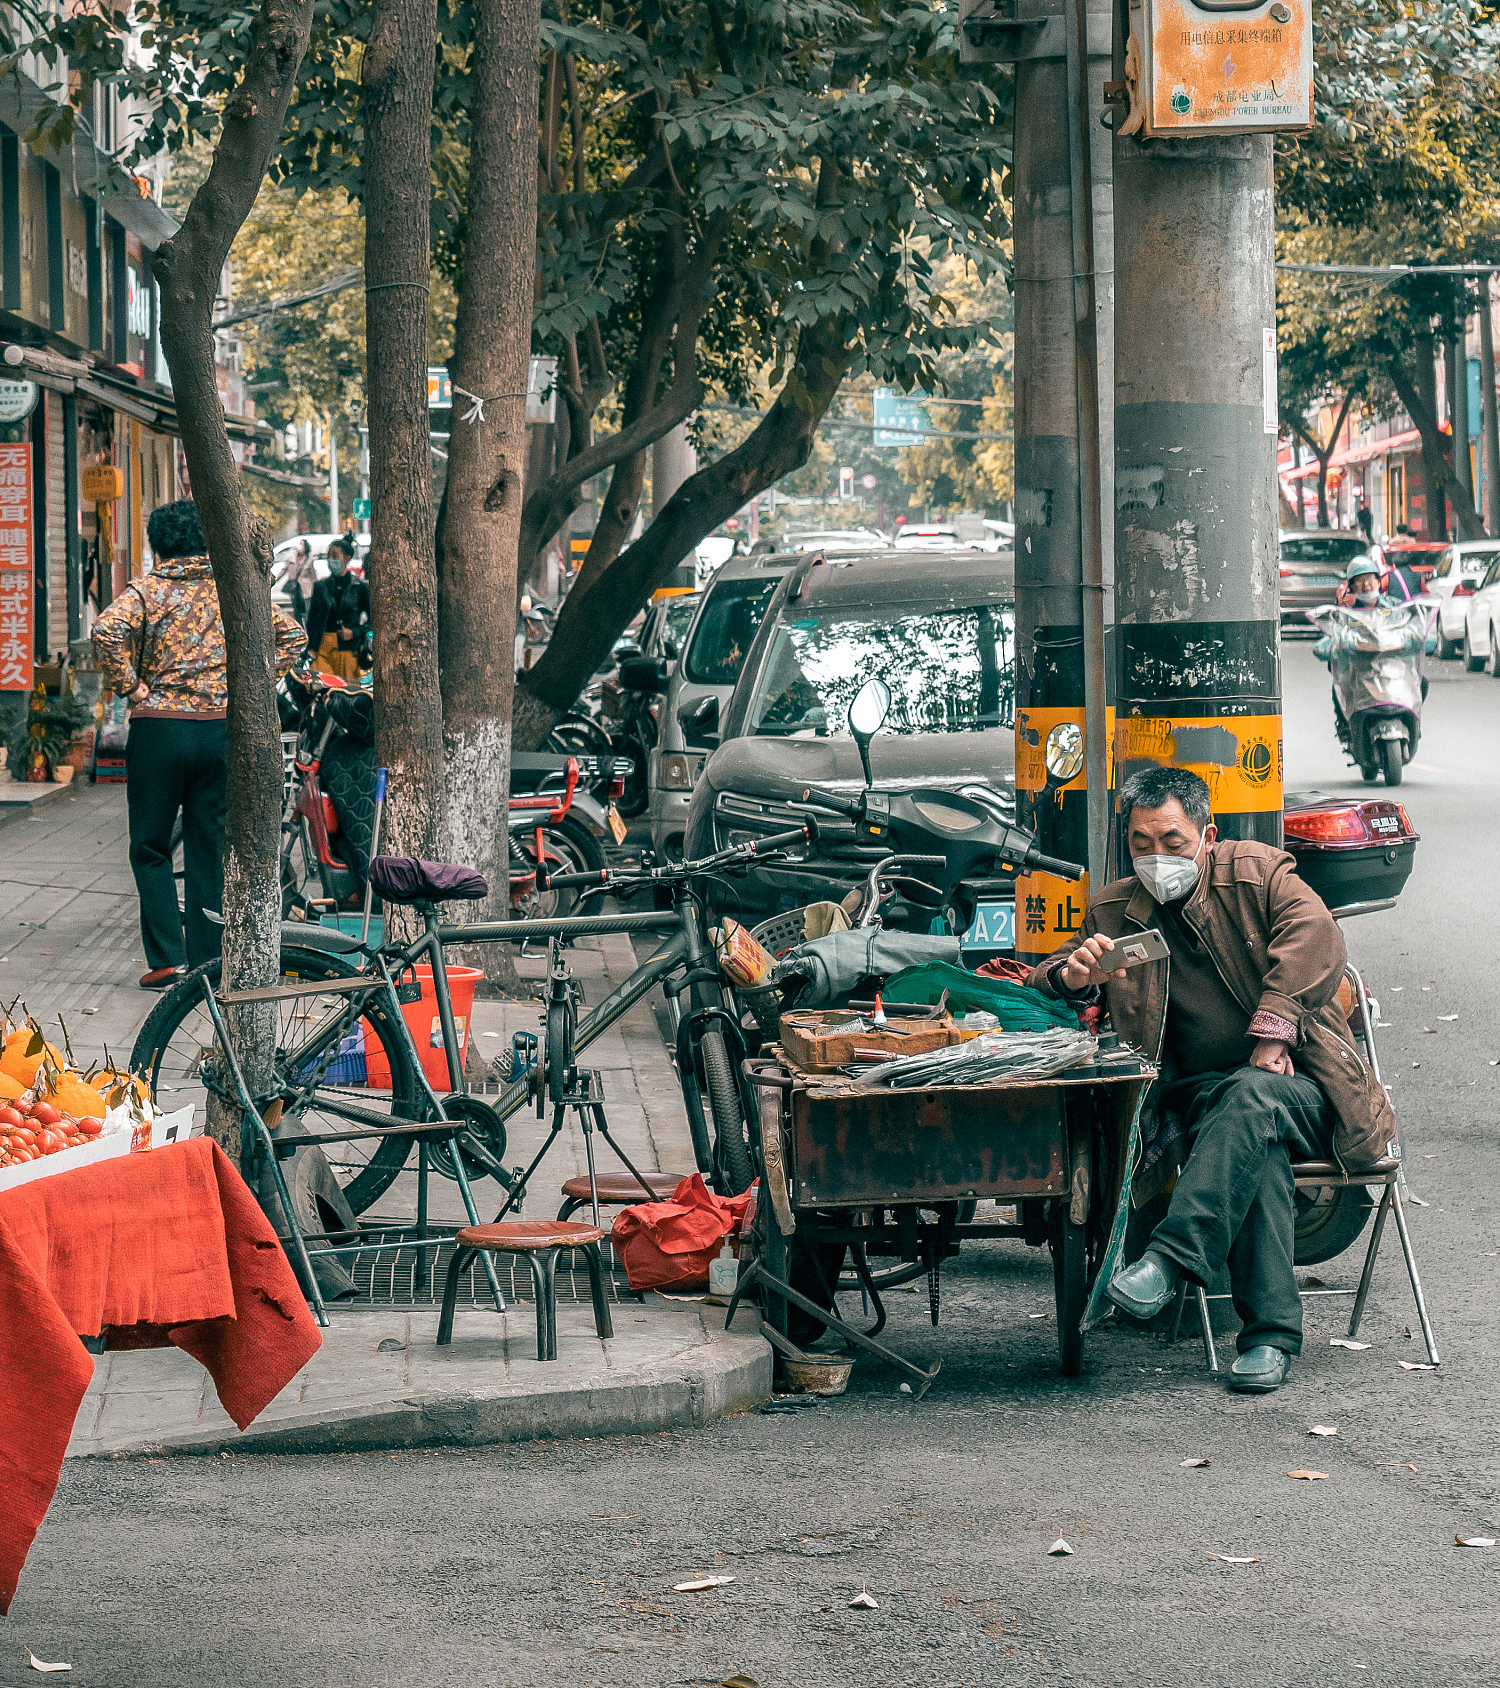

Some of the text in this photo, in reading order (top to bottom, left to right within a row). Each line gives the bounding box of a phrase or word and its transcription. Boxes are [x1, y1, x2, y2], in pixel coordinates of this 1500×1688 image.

[1180, 29, 1283, 46] 用电信息采集终端箱
[1213, 90, 1275, 103] 成都电业局
[1233, 107, 1259, 116] POWER
[1262, 105, 1292, 115] BUREAU
[0, 570, 29, 687] 韩式半永久
[1025, 894, 1081, 934] 禁止
